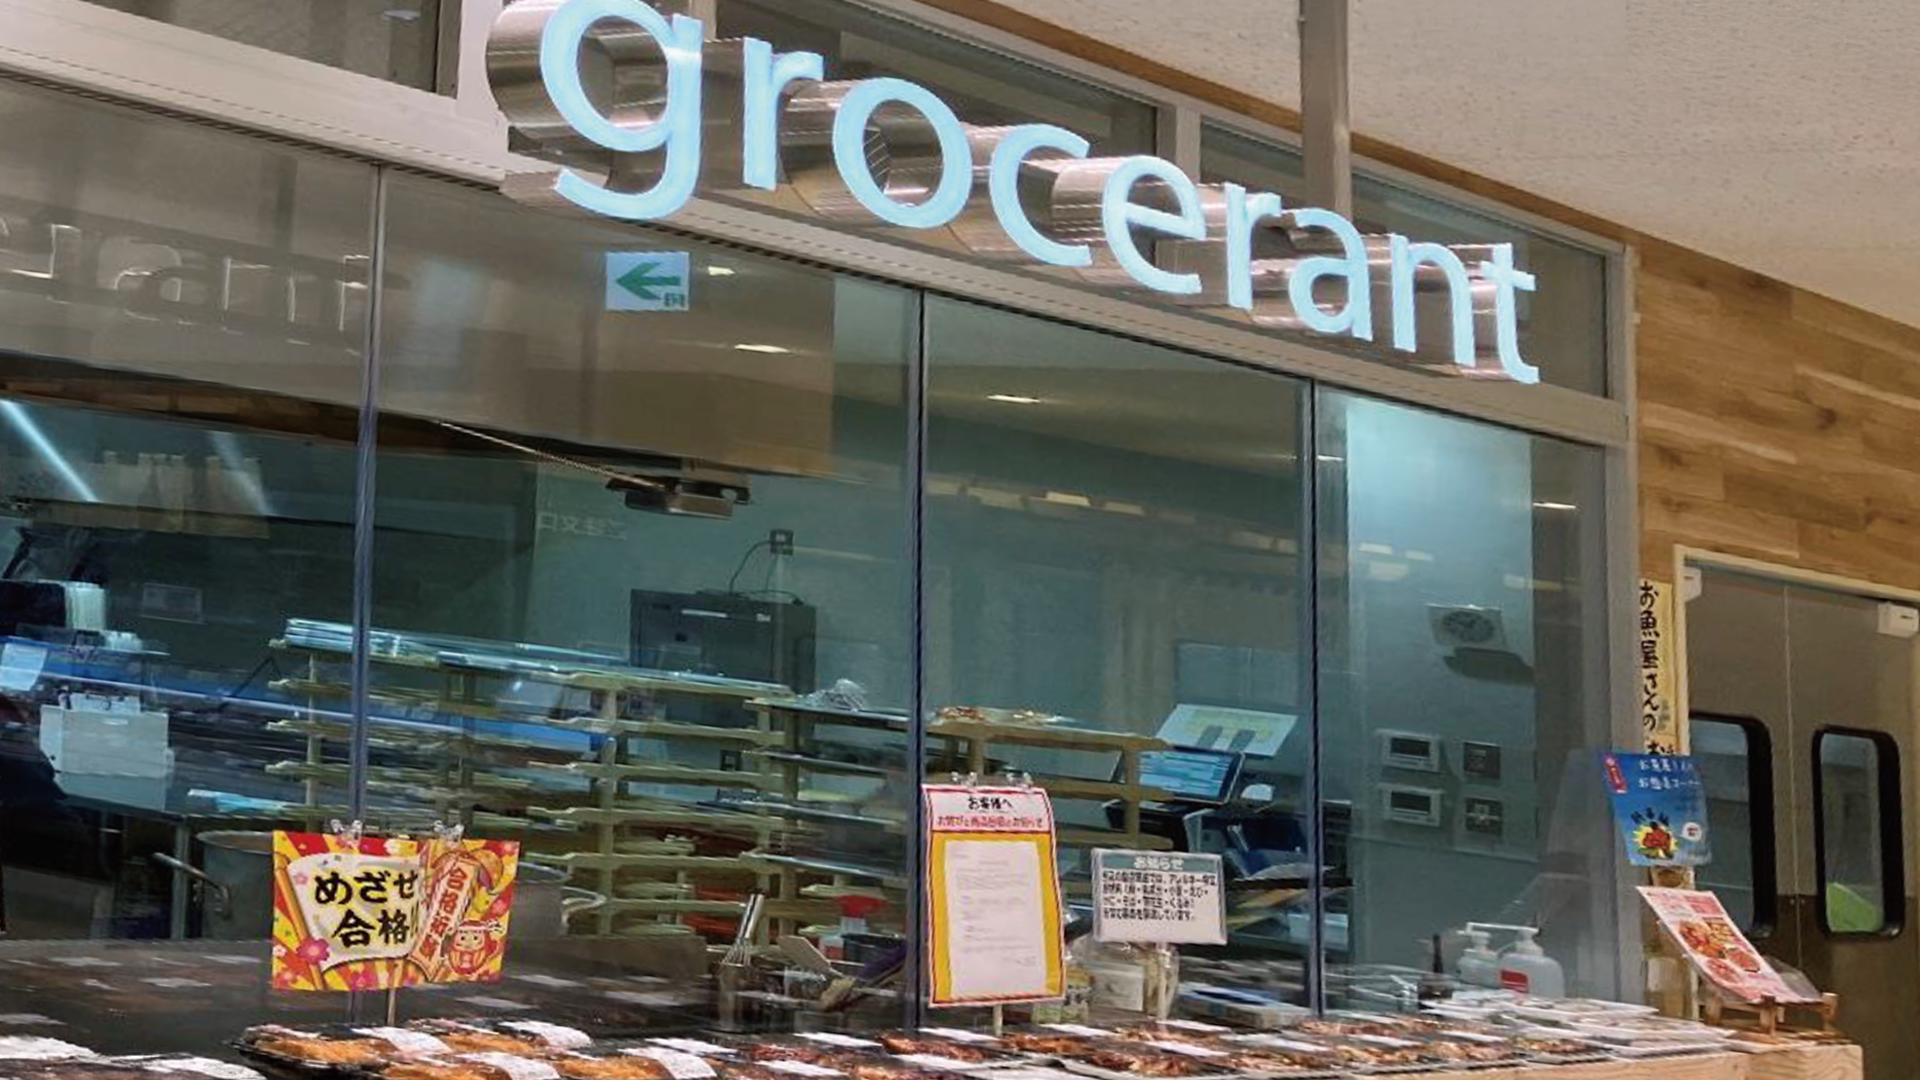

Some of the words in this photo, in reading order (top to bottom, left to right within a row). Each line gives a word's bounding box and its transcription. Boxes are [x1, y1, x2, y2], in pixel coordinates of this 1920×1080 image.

[541, 0, 1539, 384] grocerant
[967, 795, 1014, 811] お客様へ
[1133, 855, 1184, 871] お知らせ
[314, 871, 419, 905] めざせ
[332, 908, 411, 948] 合格
